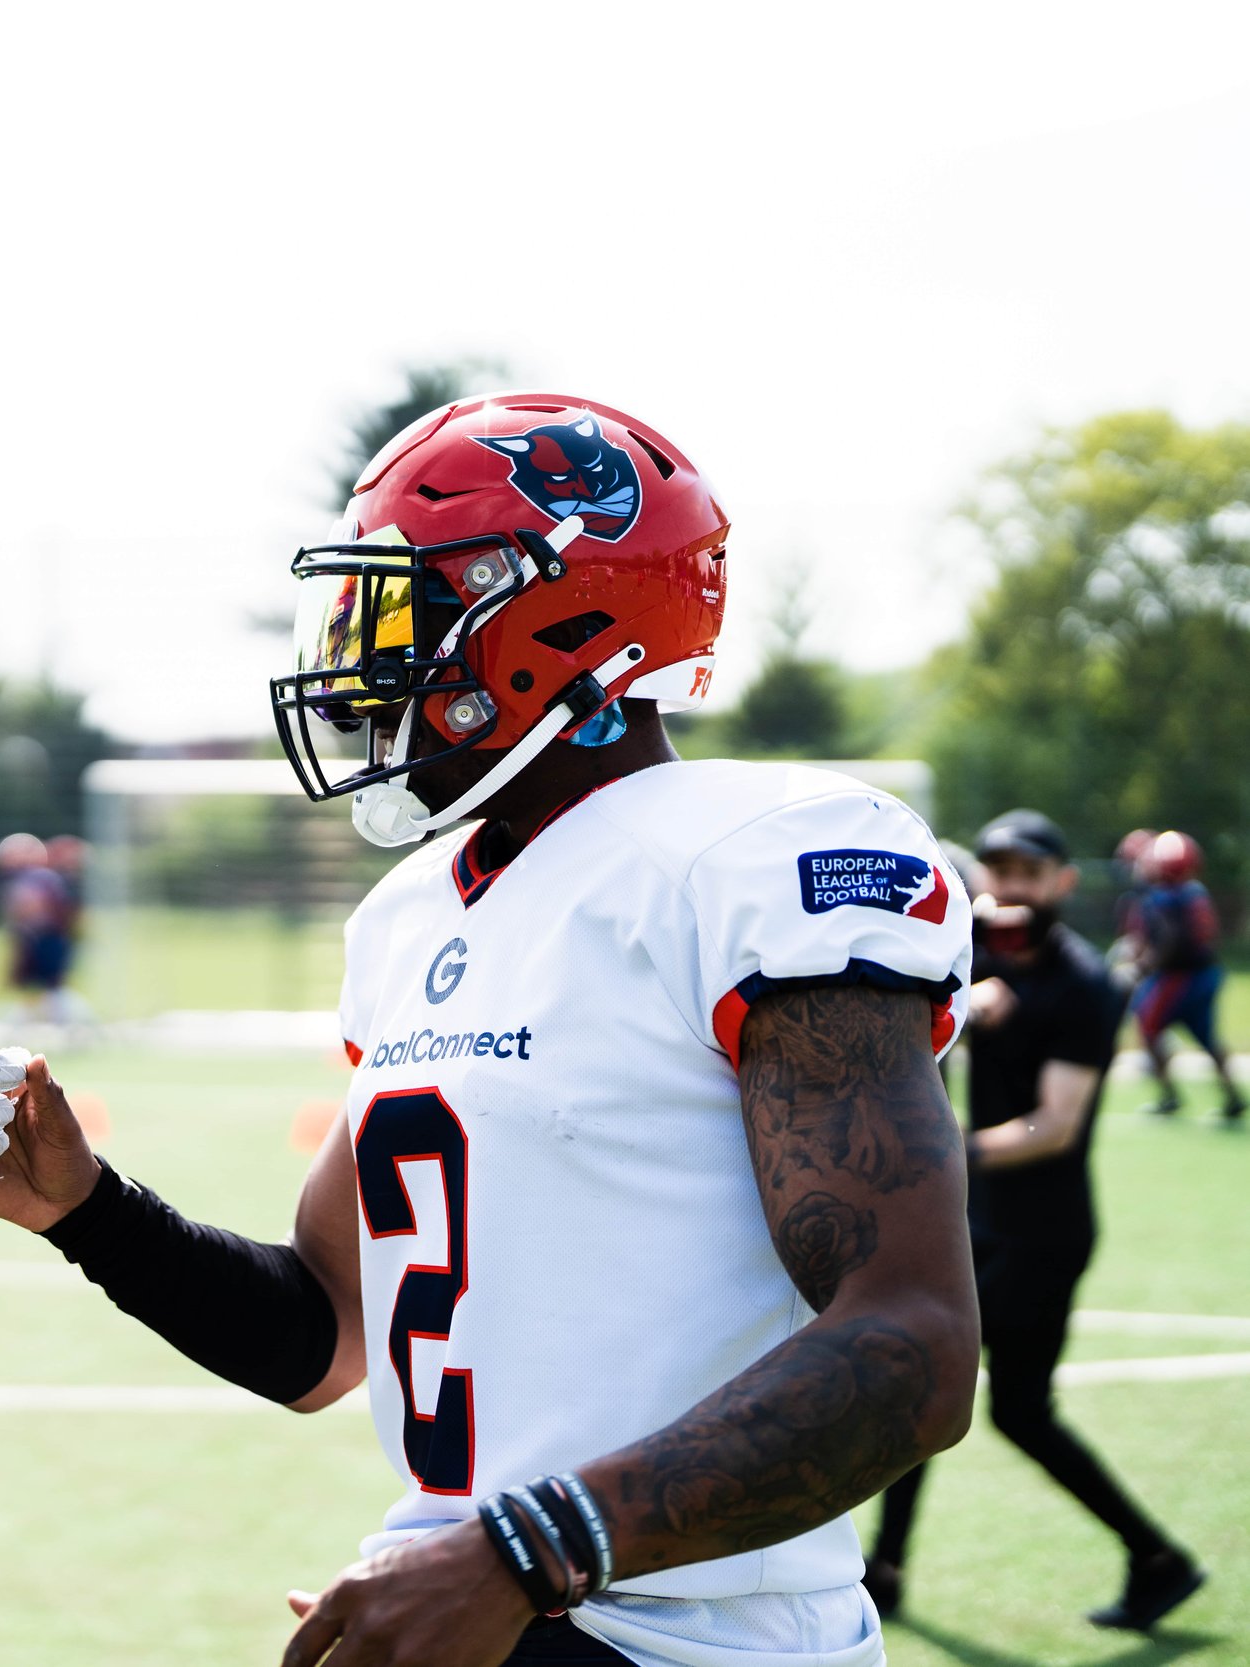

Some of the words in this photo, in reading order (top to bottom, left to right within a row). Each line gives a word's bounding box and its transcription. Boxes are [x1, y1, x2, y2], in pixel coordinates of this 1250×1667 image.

[811, 857, 898, 873] EUROPEAN
[813, 873, 874, 889] LEAGUE
[875, 876, 890, 885] OF
[814, 886, 892, 906] FOOTBALL
[425, 937, 468, 1005] G
[363, 1025, 532, 1070] balConnect
[354, 1086, 475, 1497] 2
